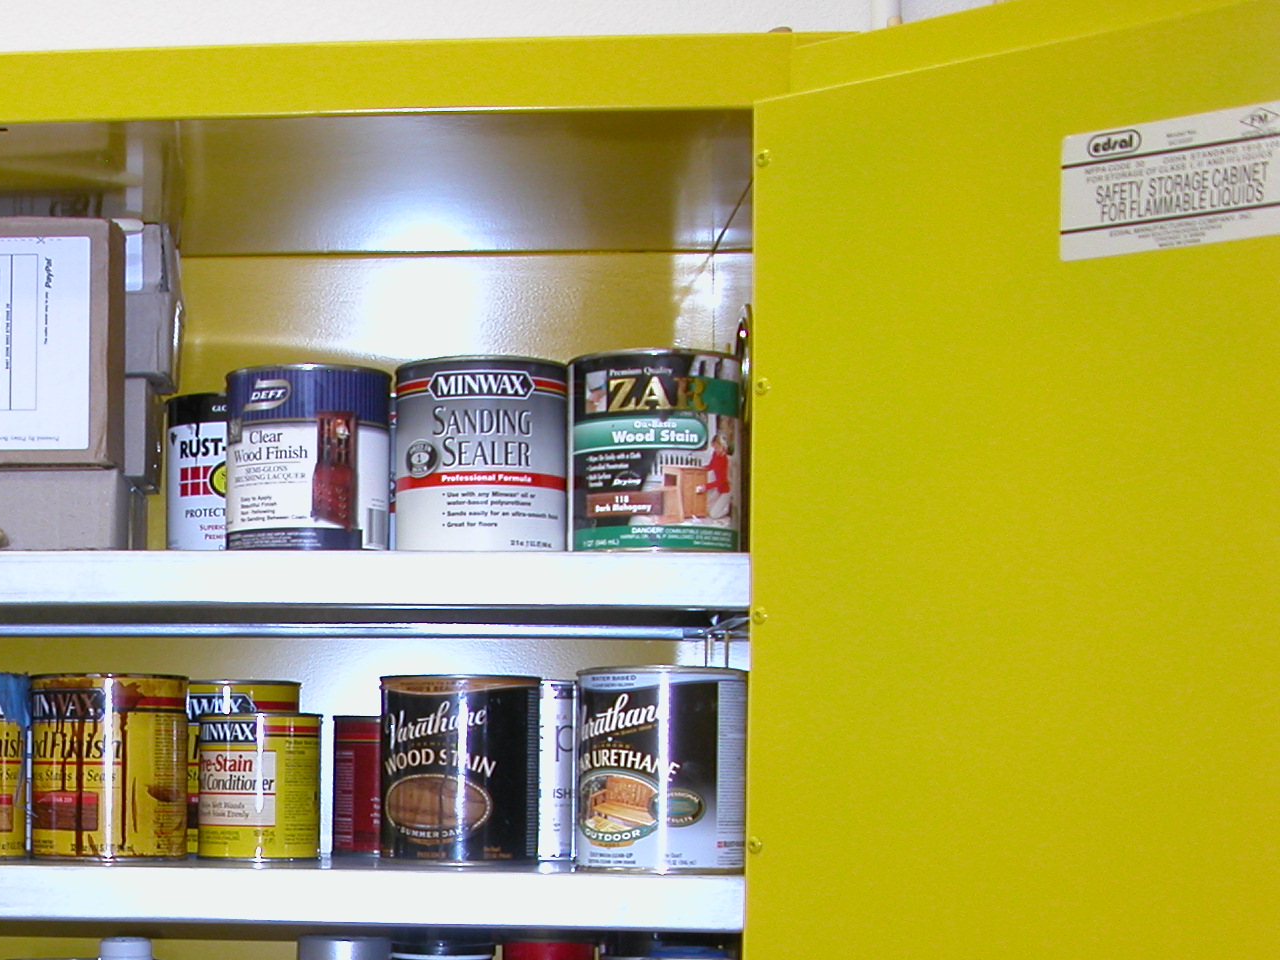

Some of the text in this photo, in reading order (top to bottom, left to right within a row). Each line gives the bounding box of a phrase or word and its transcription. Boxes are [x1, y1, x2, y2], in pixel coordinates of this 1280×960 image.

[1092, 134, 1134, 153] edsal
[1096, 161, 1269, 204] SAFETY STORAGE CABINET
[1101, 181, 1264, 222] FOR FLAMMABLE LIQUIDS
[44, 257, 54, 288] PayPal
[609, 367, 642, 377] Premium
[250, 388, 286, 401] DEFT
[437, 374, 525, 396] MINWAX
[608, 376, 708, 412] ZAR
[432, 405, 533, 437] SANDING
[249, 431, 283, 445] Clear
[612, 430, 699, 444] Wood Stain
[234, 445, 308, 464] Wood Finish
[442, 436, 531, 468] SEALER
[269, 472, 306, 482] LACQUER
[441, 474, 532, 483] Professional Formula
[591, 674, 610, 682] WATER
[581, 693, 659, 742] arathan
[201, 723, 255, 741] INWAX
[384, 748, 435, 776] WOOD
[400, 827, 439, 839] SUMMER
[584, 828, 641, 842] OUTDOOR
